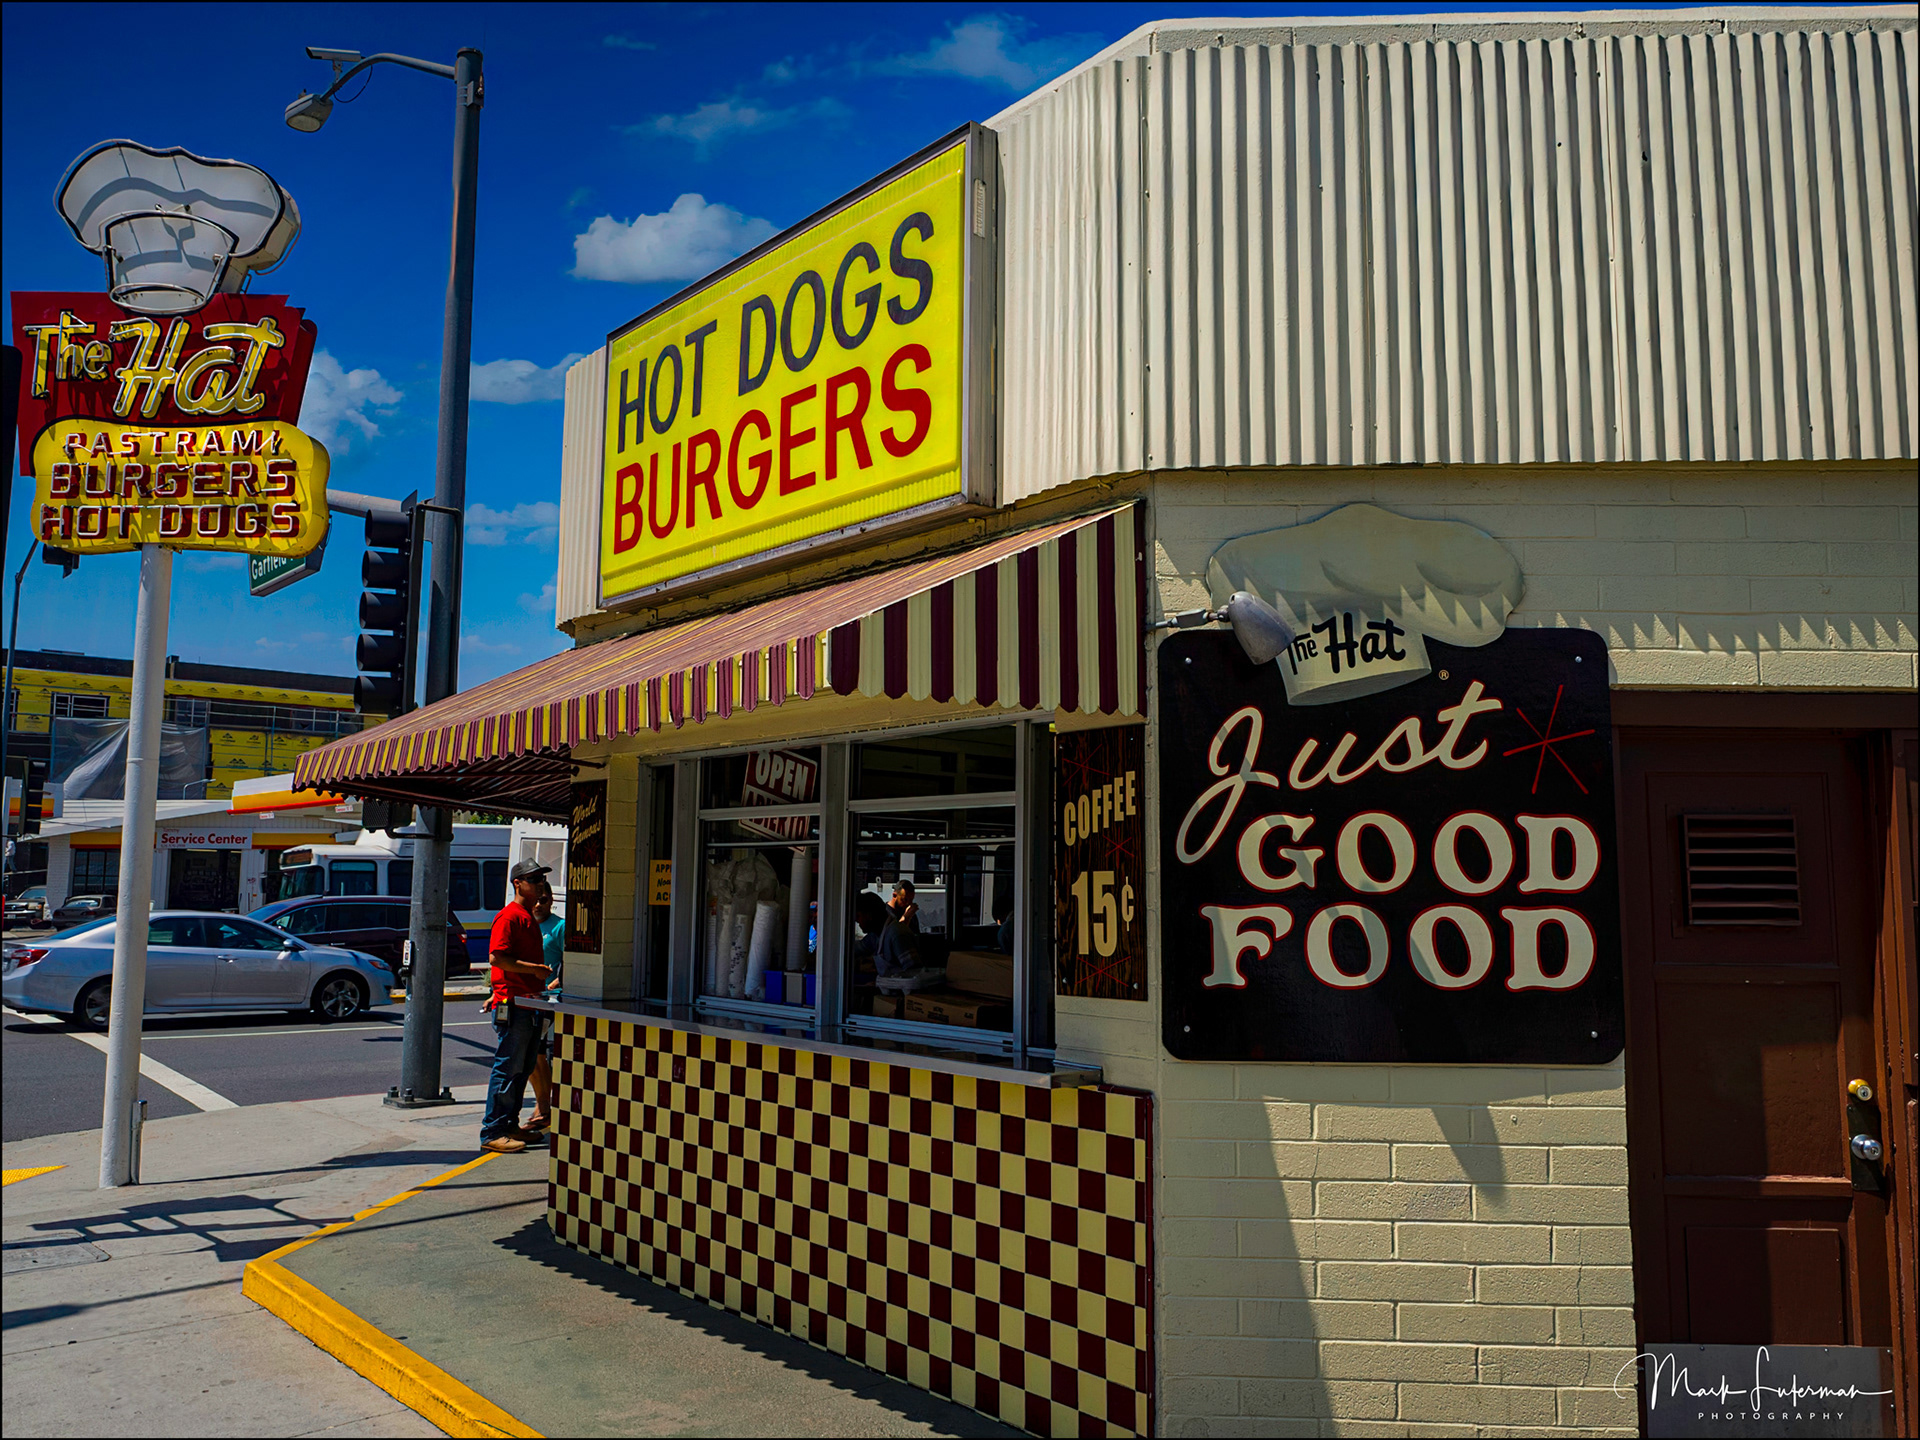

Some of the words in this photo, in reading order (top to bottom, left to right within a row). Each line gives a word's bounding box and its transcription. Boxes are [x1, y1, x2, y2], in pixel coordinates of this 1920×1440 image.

[617, 319, 717, 454] HOT
[738, 211, 935, 397] DOGS
[23, 309, 113, 398] The
[108, 315, 286, 418] Hat
[64, 429, 282, 458] PASTRAMI
[613, 343, 932, 555] BURGERS
[50, 458, 300, 499] BURGERS
[40, 502, 139, 541] HOT
[158, 502, 301, 540] DOGS
[1287, 632, 1319, 676] The
[1311, 611, 1406, 674] Hat
[755, 749, 809, 801] OPEN
[1175, 680, 1503, 865] Just
[573, 794, 599, 826] World
[1063, 770, 1137, 847] COFFEE
[161, 832, 206, 845] Service
[207, 832, 248, 845] Center
[572, 819, 602, 852] Famous
[1236, 809, 1600, 895] GOOD
[568, 861, 600, 891] Pastrami
[576, 902, 588, 935] Dip
[1200, 902, 1598, 992] FOOD
